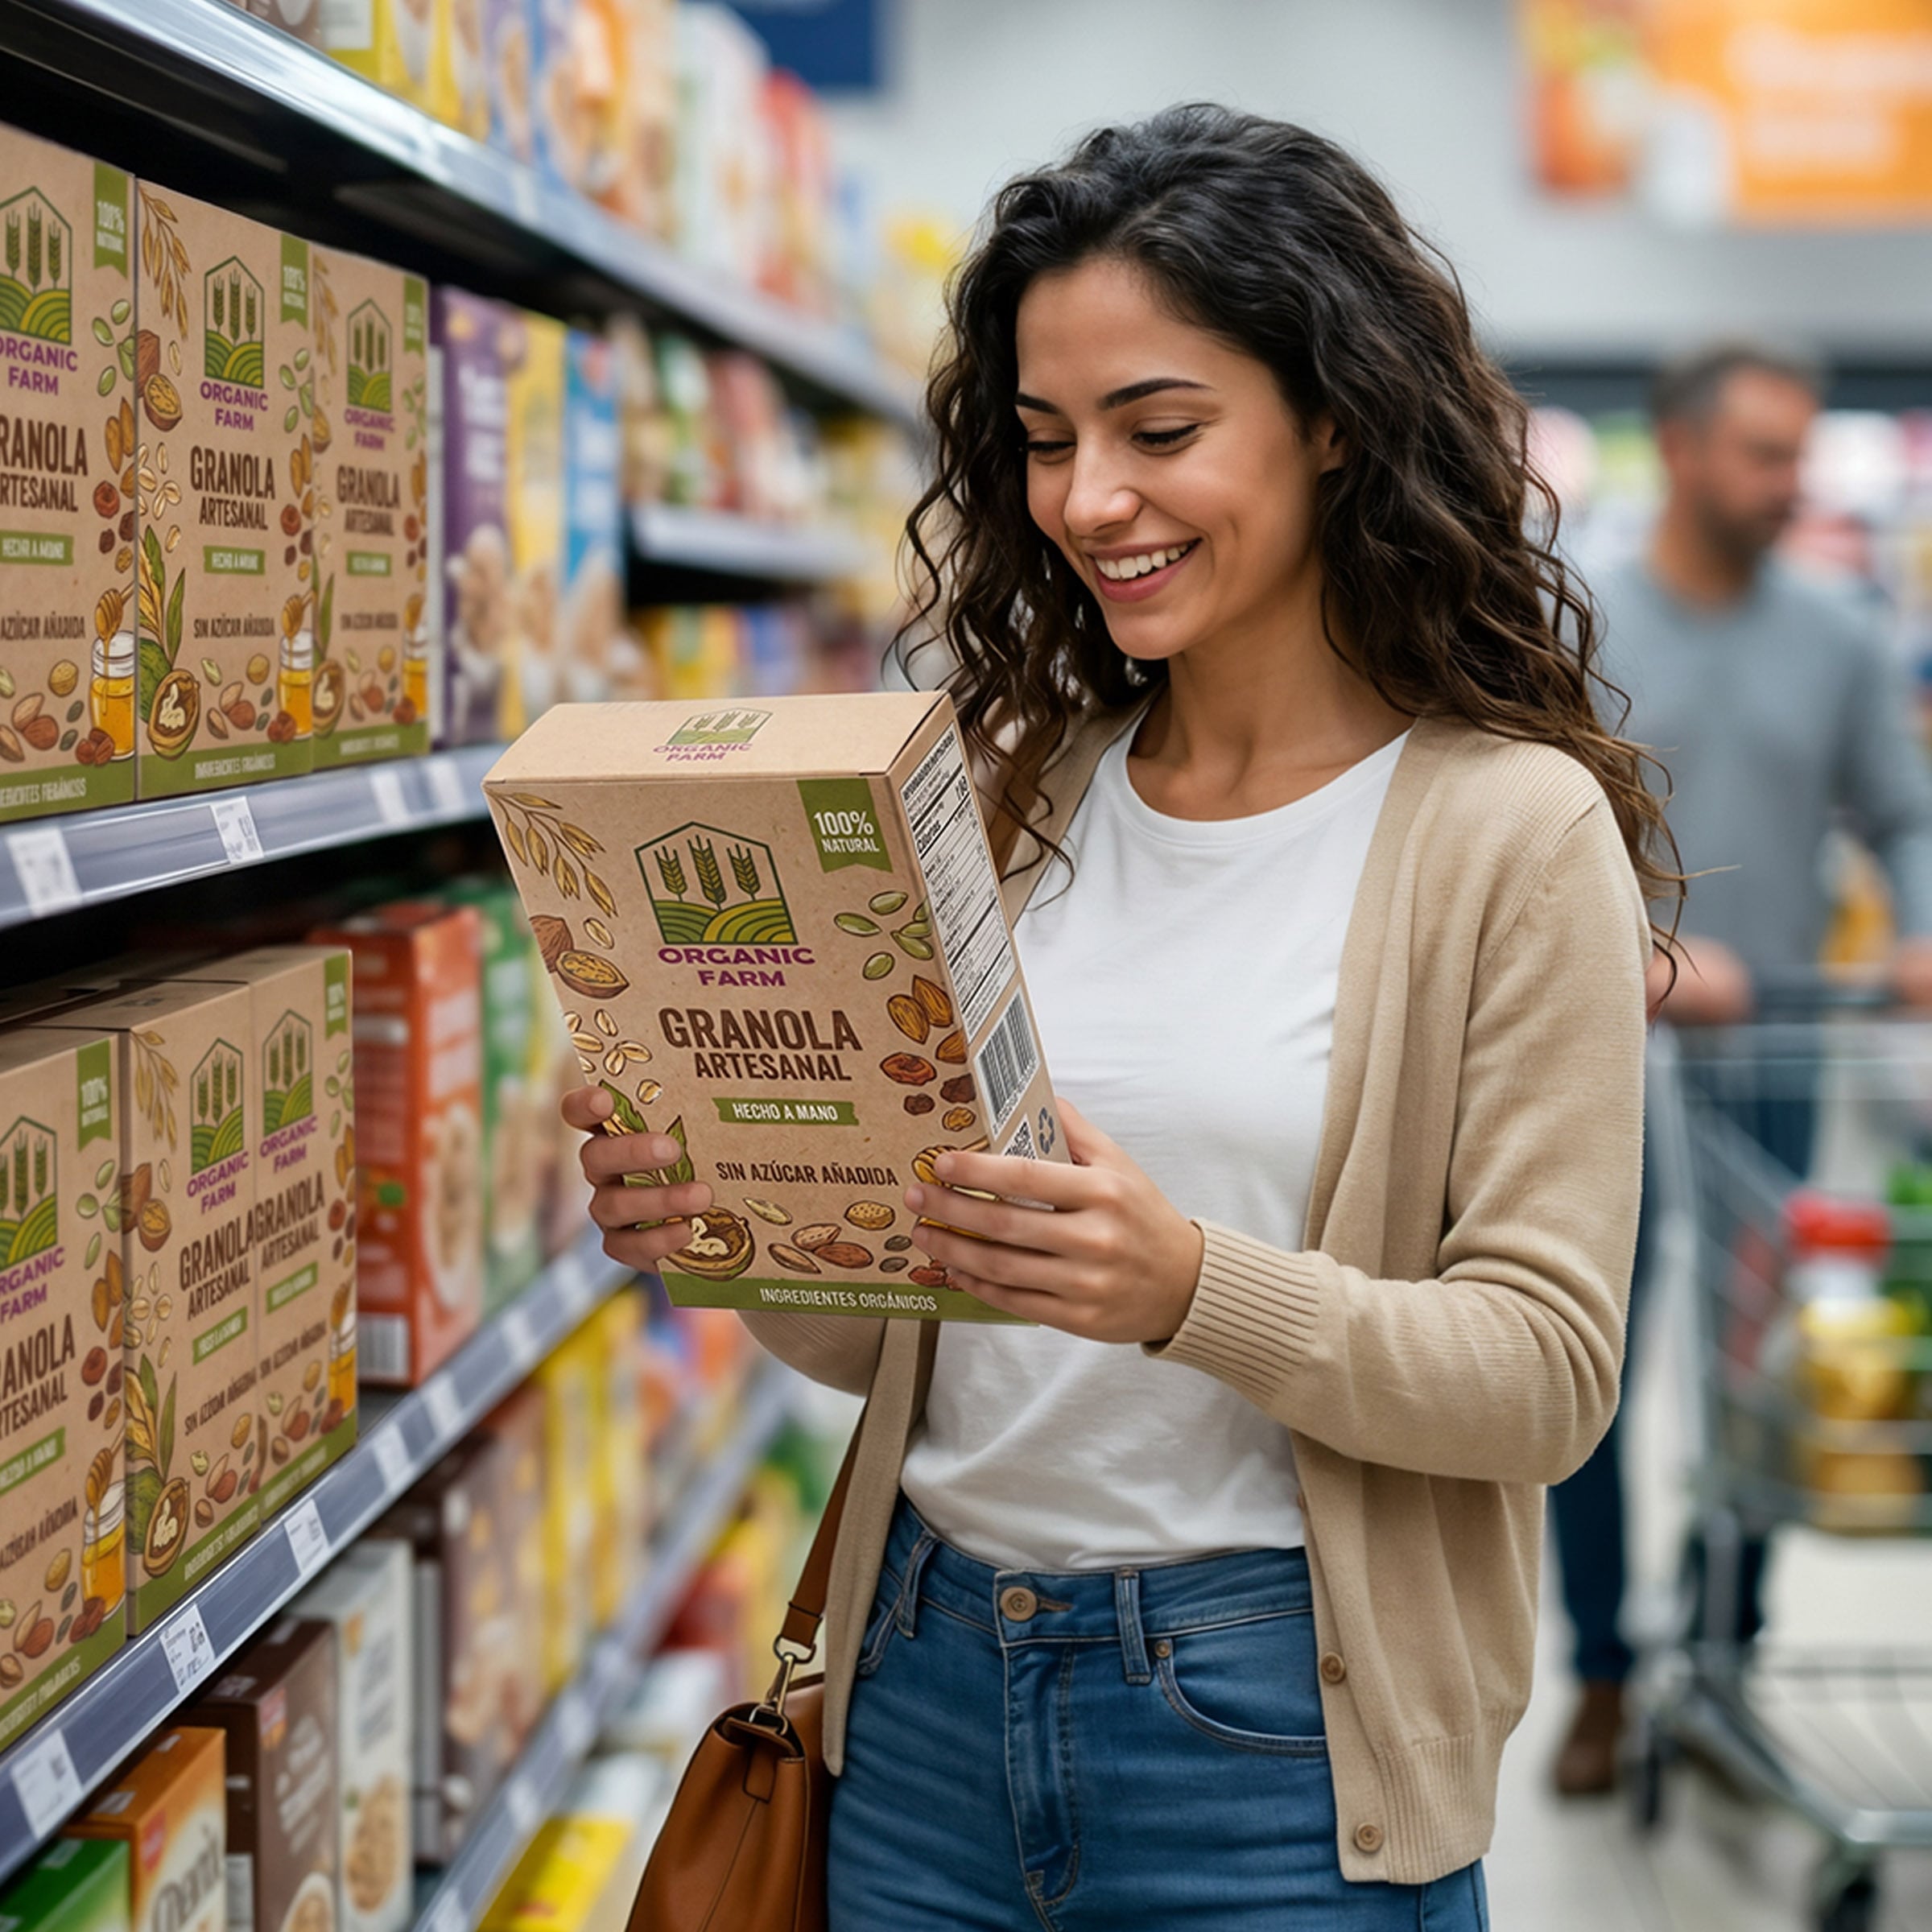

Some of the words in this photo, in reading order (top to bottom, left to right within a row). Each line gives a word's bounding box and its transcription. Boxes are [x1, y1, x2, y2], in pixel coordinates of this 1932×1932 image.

[9, 365, 59, 396] FARM
[200, 381, 268, 411] ORGANIC
[215, 408, 254, 431] FARM
[190, 445, 275, 500] GRANOLA
[200, 497, 268, 530] ARTESANAL
[653, 743, 753, 753] ORGANIC
[666, 753, 726, 762] FARM
[814, 811, 874, 836] 100%
[821, 838, 880, 852] NATURAL
[658, 947, 815, 964] ORGANIC
[698, 970, 786, 986] FARM
[658, 1008, 863, 1051] GRANOLA
[694, 1052, 852, 1081] ARTESANAL
[732, 1102, 781, 1120] HECHO
[784, 1105, 795, 1120] A
[795, 1104, 838, 1121] MANO
[187, 1151, 250, 1198] ORGANIC
[716, 1162, 746, 1181] SIN
[751, 1160, 818, 1183] AZÚCAR
[823, 1162, 899, 1187] AÑADIDA
[201, 1182, 236, 1215] FARM
[255, 1171, 324, 1243] GRANOLA
[179, 1209, 255, 1291] GRANOLA
[0, 1283, 47, 1323] FARM
[188, 1257, 250, 1321] ARTESANAL
[760, 1288, 857, 1307] INGREDIENTES
[860, 1292, 937, 1311] ORGÁNICOS
[0, 1313, 75, 1402] ANOLA
[0, 1371, 68, 1440] TESANAL
